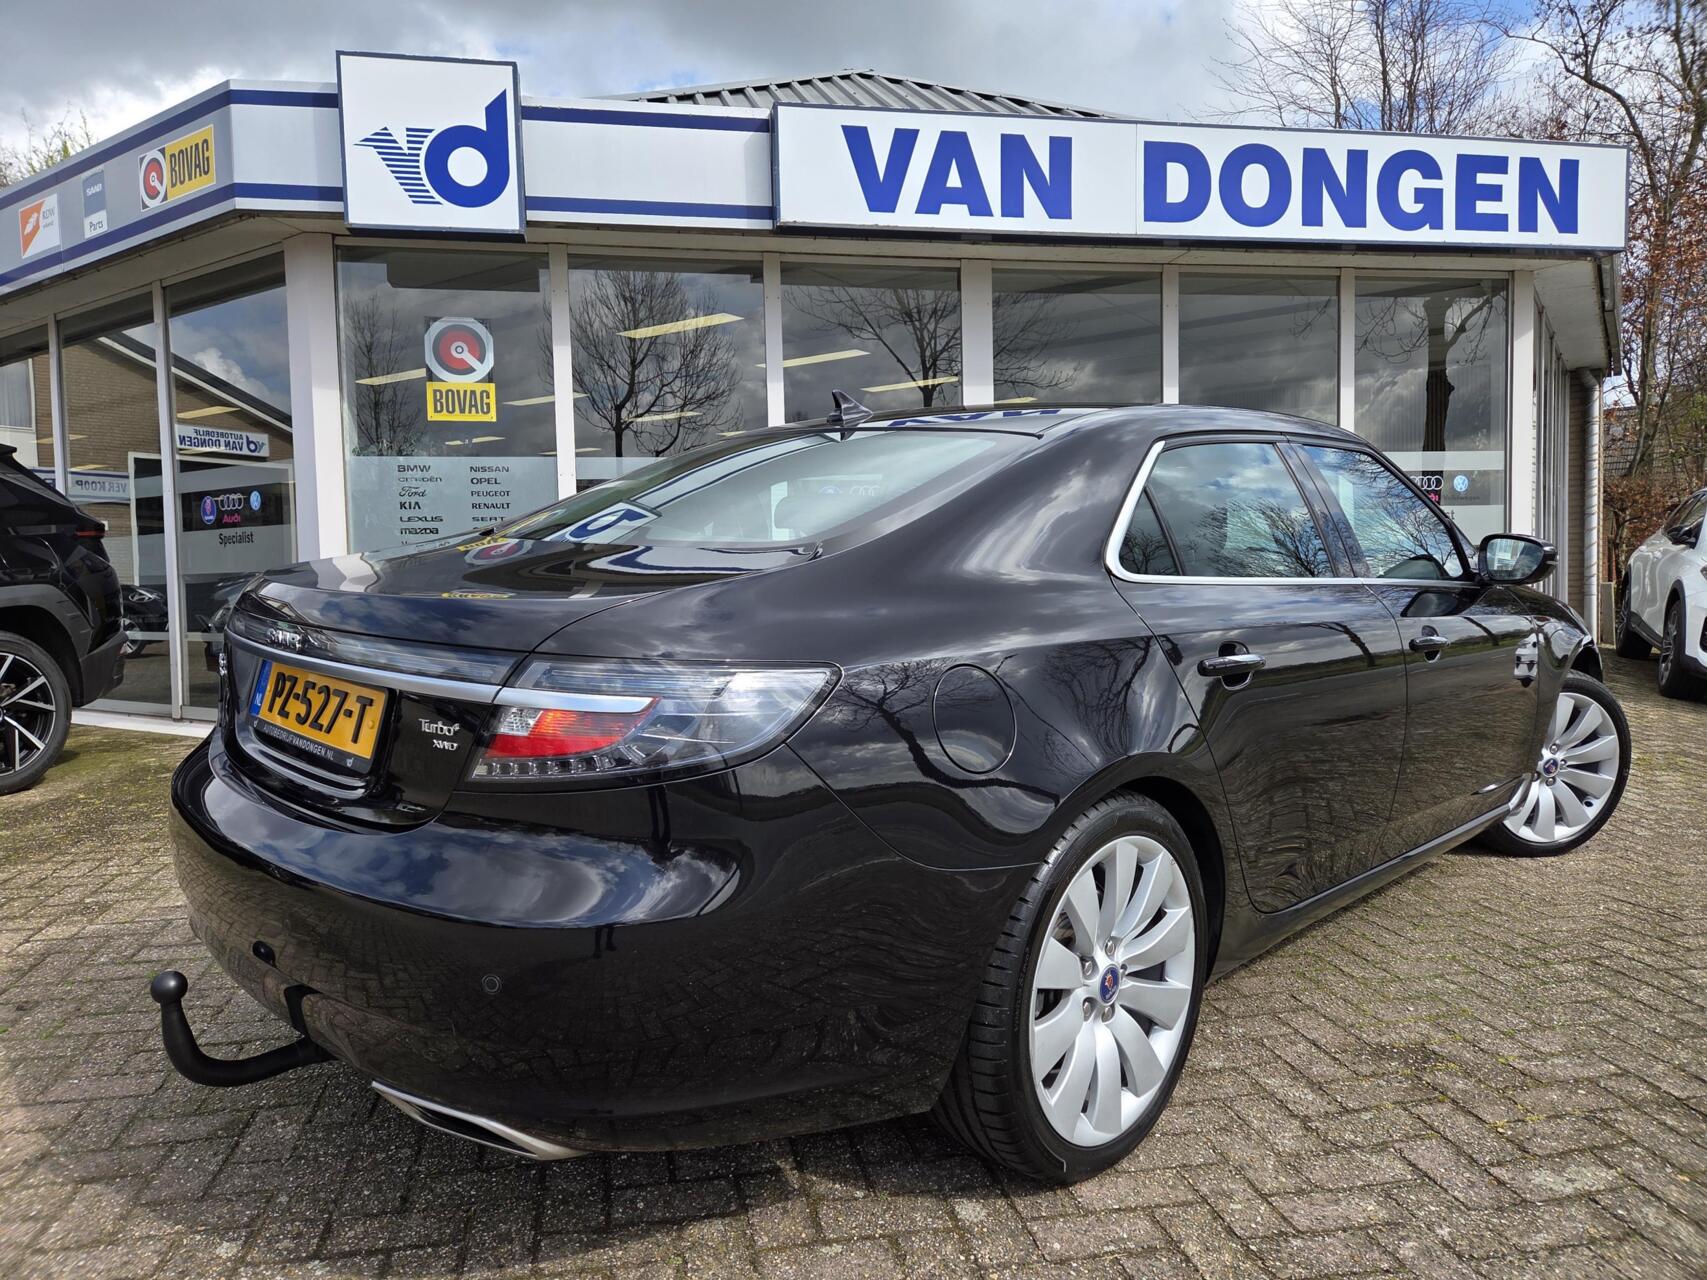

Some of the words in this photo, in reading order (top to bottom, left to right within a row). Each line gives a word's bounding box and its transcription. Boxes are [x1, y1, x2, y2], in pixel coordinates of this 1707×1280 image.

[169, 138, 210, 189] BOVAG
[841, 125, 1072, 220] VAN
[1143, 141, 1579, 234] DONGEN
[89, 220, 104, 232] Parts
[432, 388, 491, 415] BOVAG
[397, 464, 431, 473] BMW
[469, 465, 510, 473] NISSAN
[470, 477, 501, 485] OPEL
[398, 485, 427, 497] Ford
[399, 501, 422, 510] KIA
[222, 513, 241, 523] Audi
[218, 531, 254, 547] Specialist
[267, 671, 374, 745] PZ-527-T
